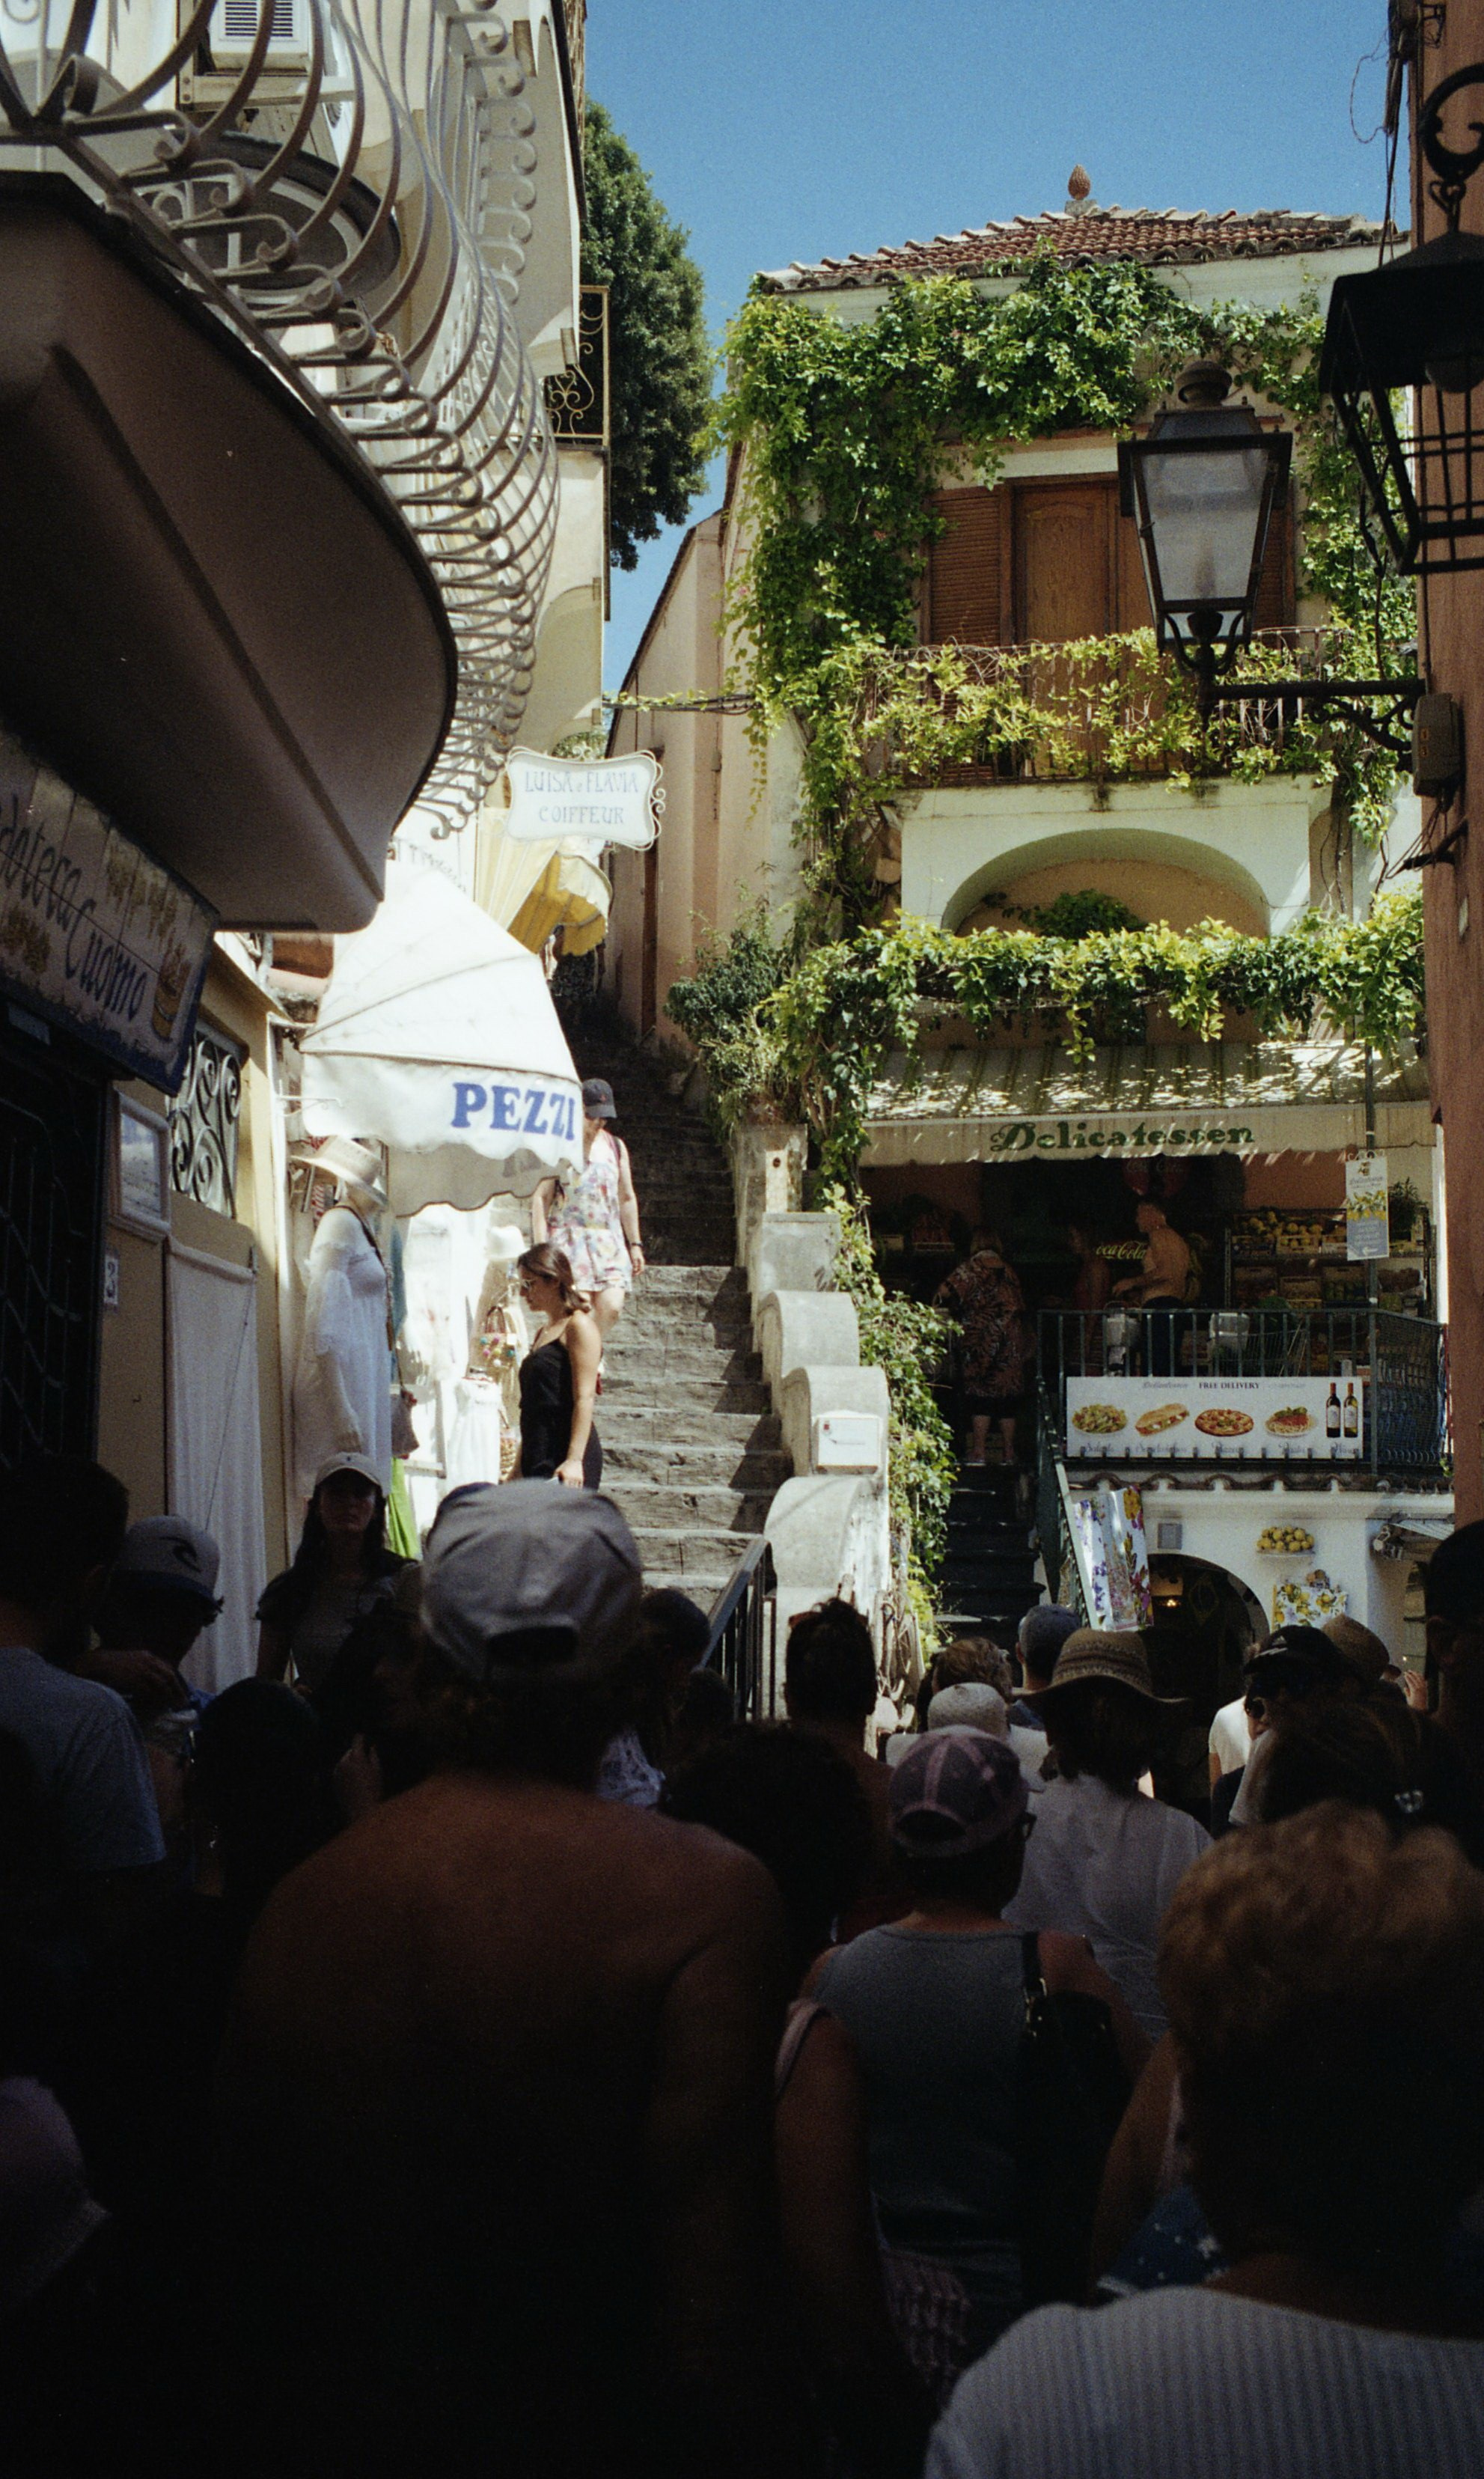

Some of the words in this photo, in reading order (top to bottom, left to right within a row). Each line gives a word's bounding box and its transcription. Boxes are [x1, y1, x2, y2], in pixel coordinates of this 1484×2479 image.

[525, 770, 573, 793] LUISA
[586, 771, 639, 793] FLAVIA
[539, 805, 624, 824] COIFFEUR
[65, 898, 147, 1022] Cuomo
[450, 1082, 575, 1141] PEZZI
[990, 1120, 1255, 1153] Delicatessen
